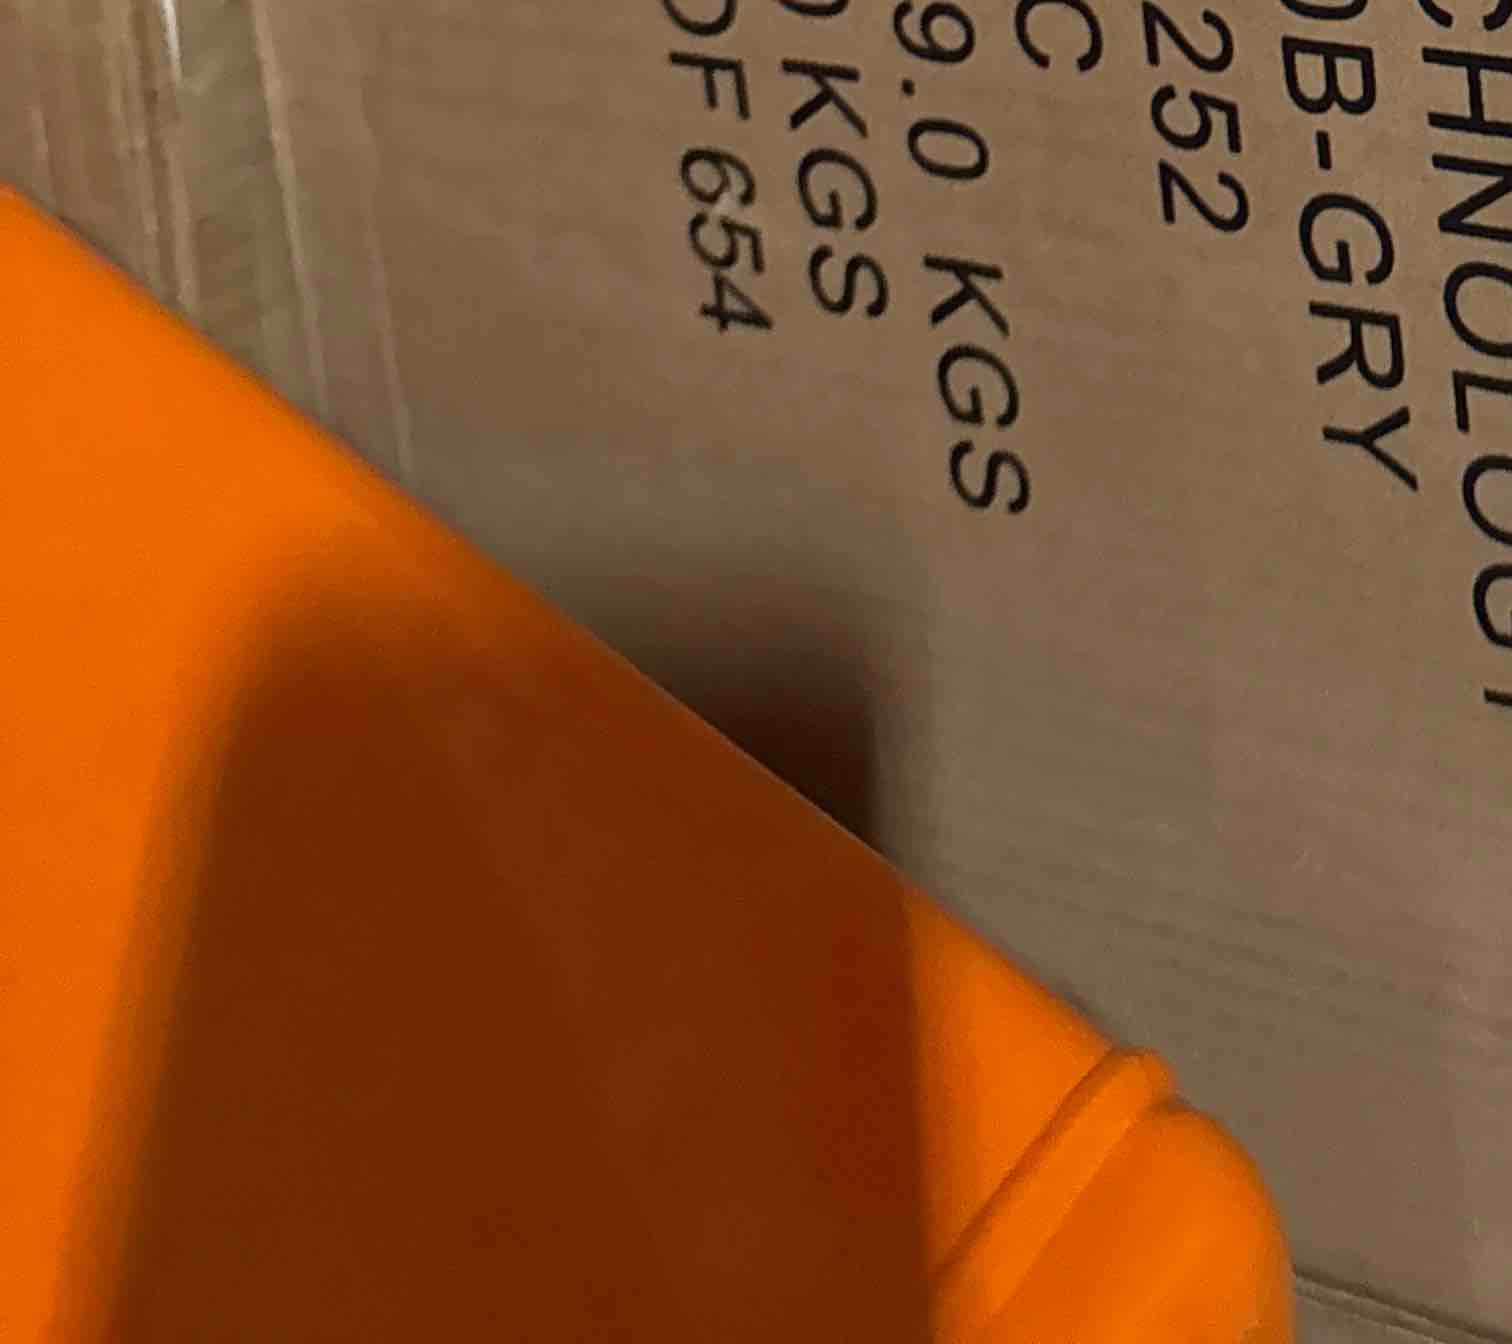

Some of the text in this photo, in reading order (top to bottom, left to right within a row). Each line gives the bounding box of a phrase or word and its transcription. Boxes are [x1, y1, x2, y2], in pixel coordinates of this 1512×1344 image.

[678, 147, 772, 334] 654
[782, 58, 888, 320] KGS
[923, 254, 1031, 516] KGS
